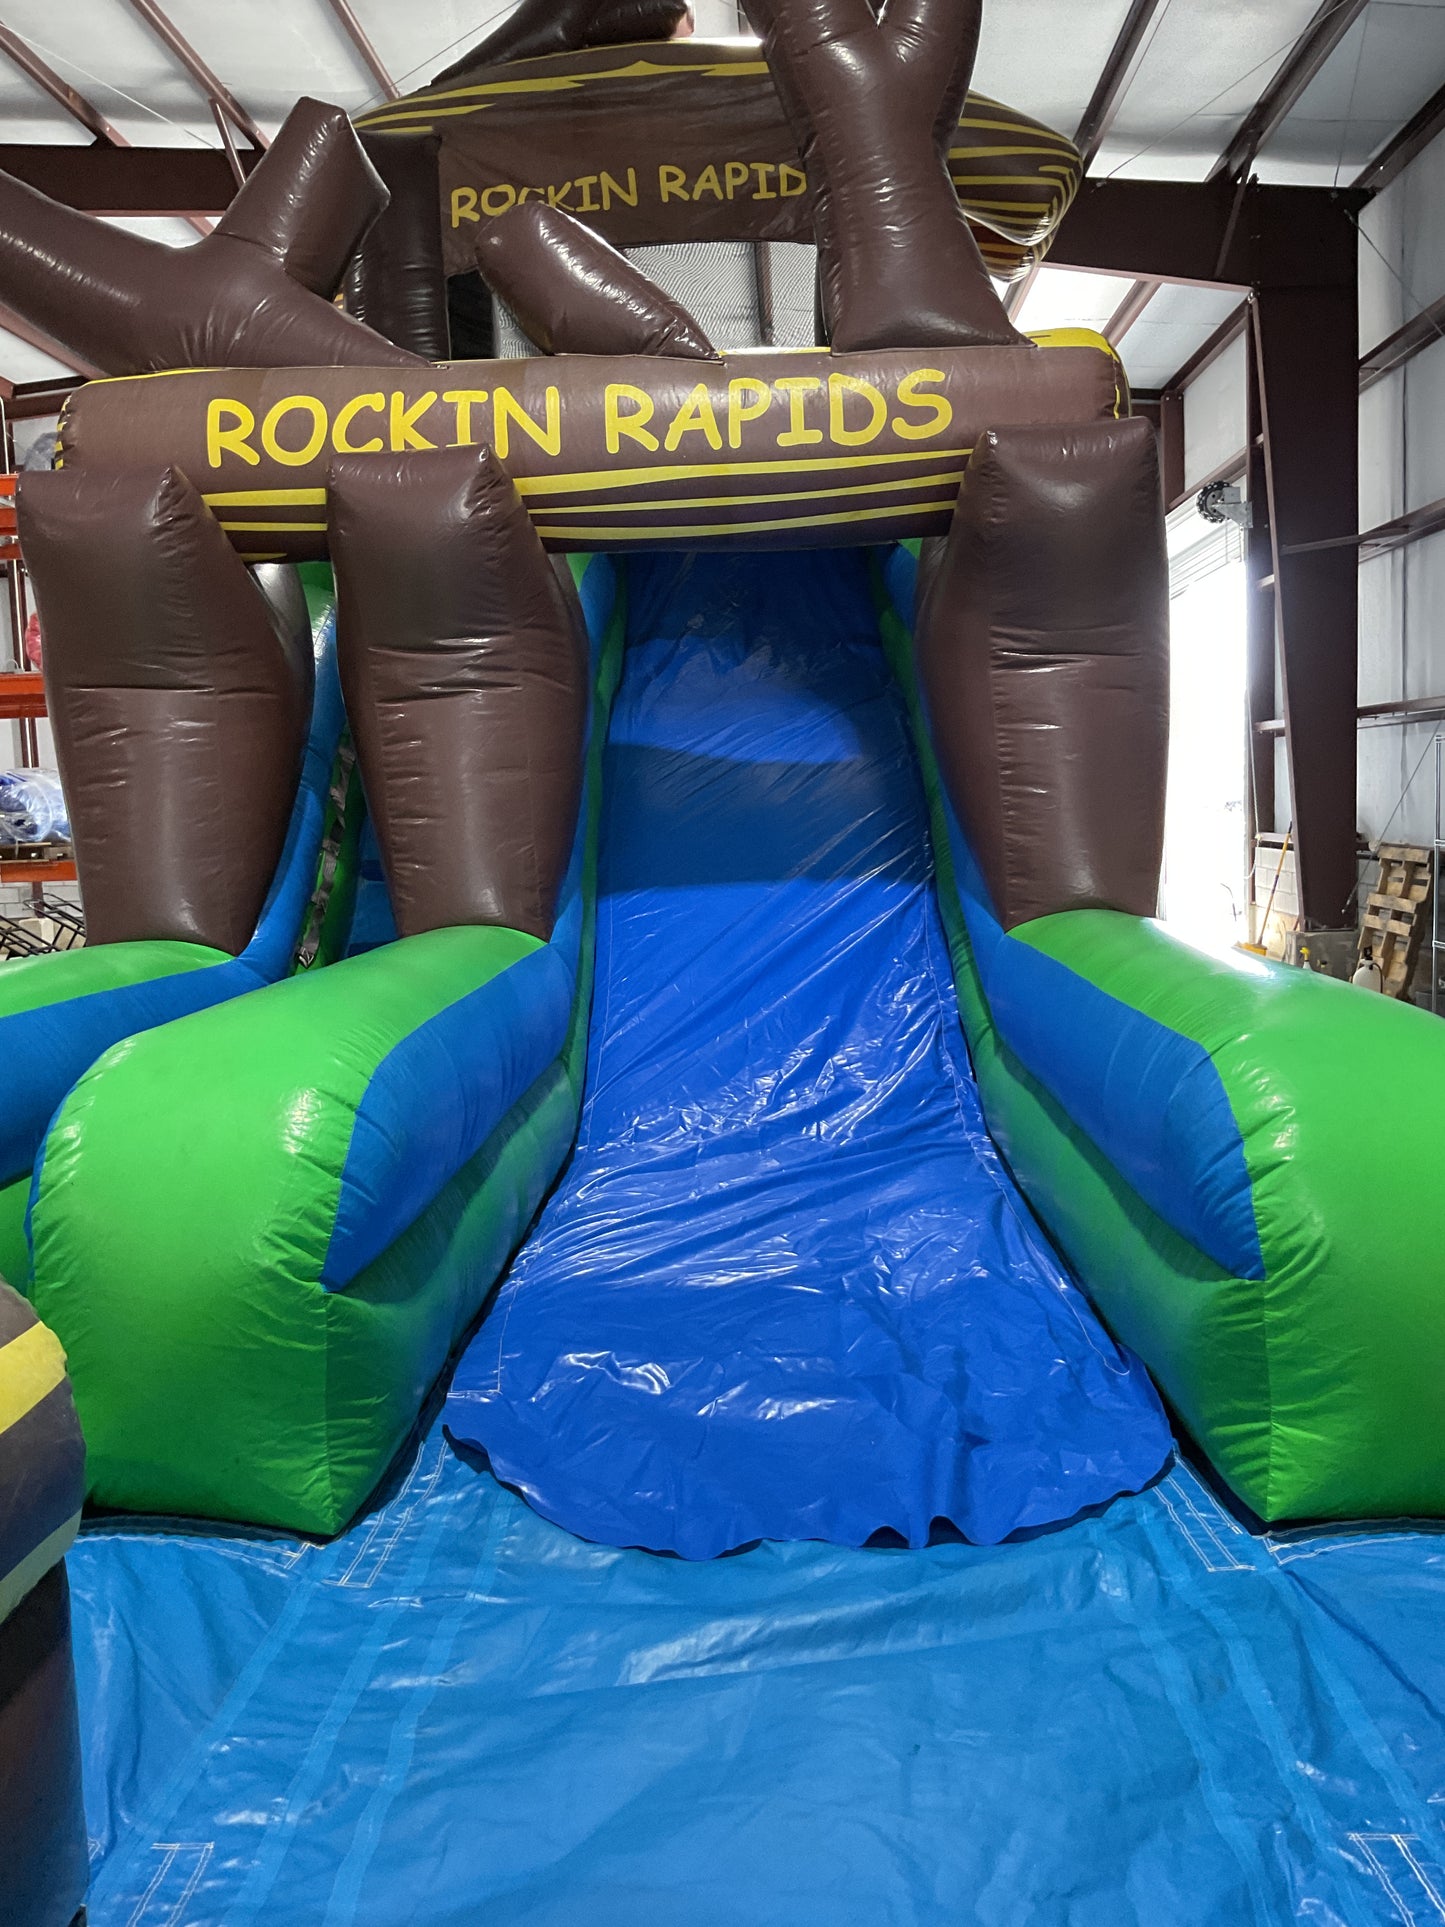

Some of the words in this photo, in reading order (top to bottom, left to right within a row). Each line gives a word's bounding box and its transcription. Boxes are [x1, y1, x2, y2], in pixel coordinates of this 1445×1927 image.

[658, 162, 807, 202] RAPID
[205, 385, 562, 469] ROCKIN
[604, 367, 954, 455] RAPIDS
